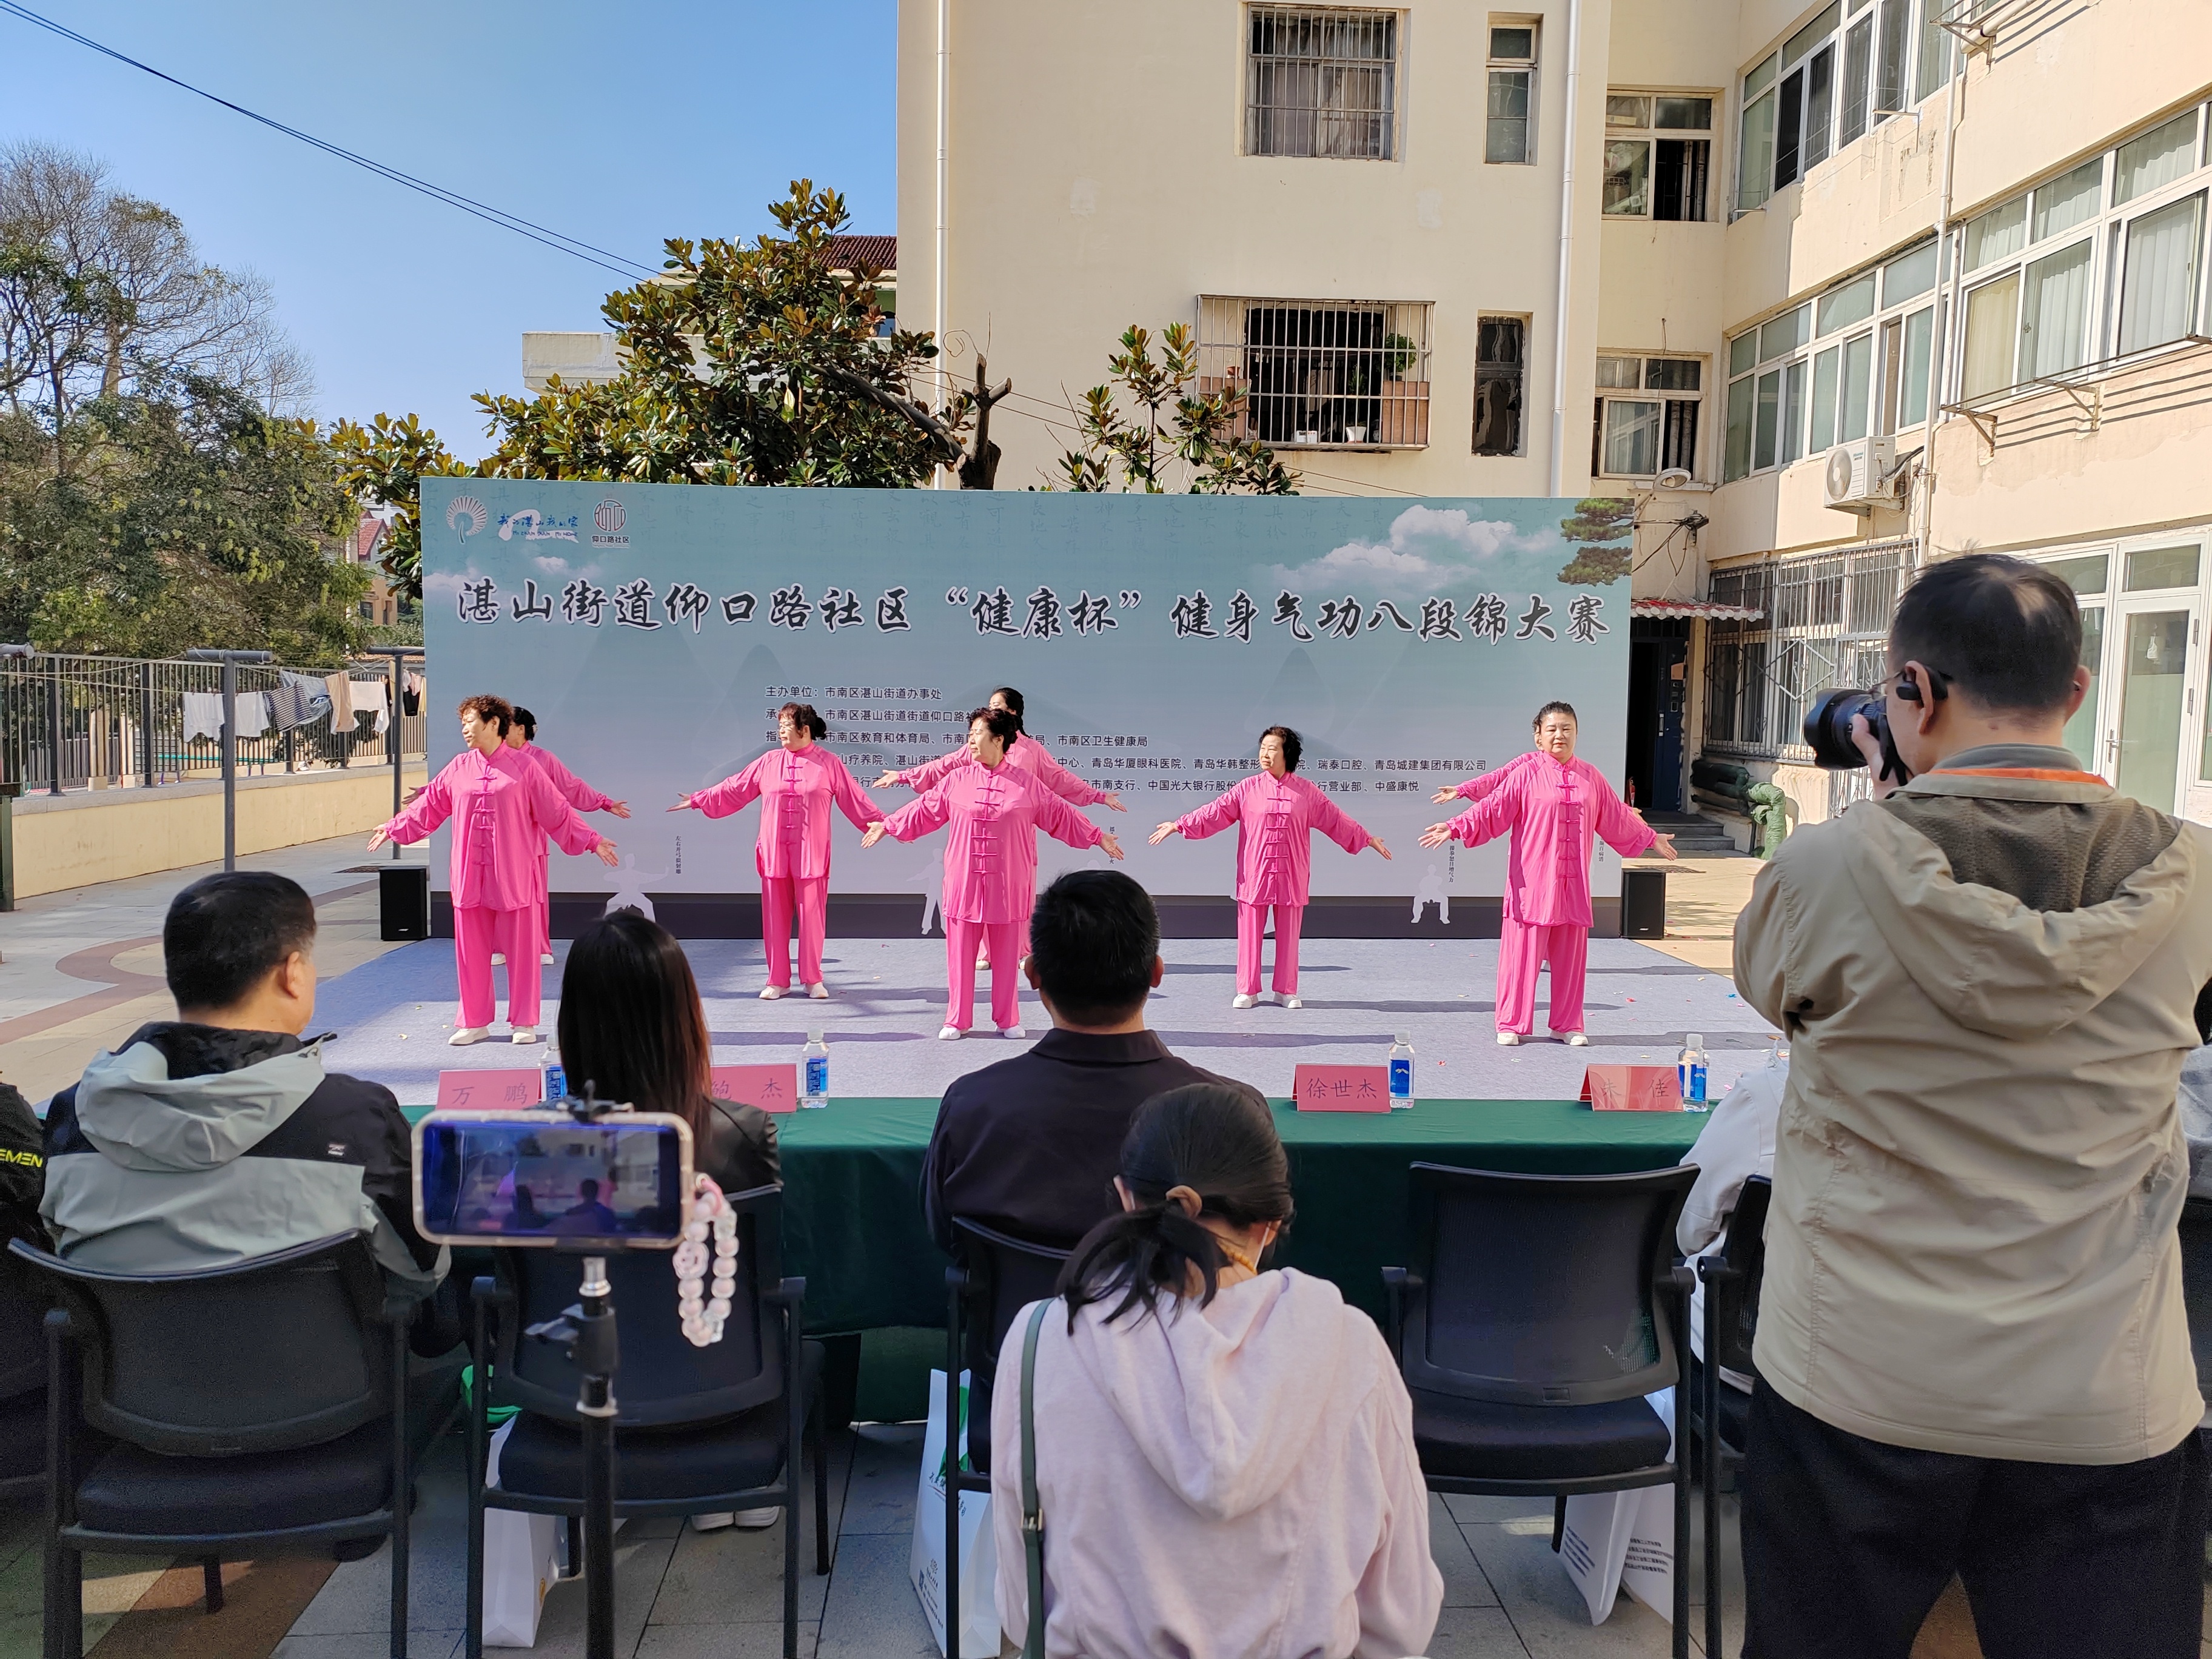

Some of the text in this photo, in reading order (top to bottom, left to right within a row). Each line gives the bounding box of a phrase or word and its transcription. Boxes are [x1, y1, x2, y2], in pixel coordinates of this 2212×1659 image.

[458, 578, 911, 633] 湛山街道仰口路社区
[1170, 590, 1610, 645] 健身气功八段锦大赛
[1306, 1077, 1377, 1099] 徐世杰
